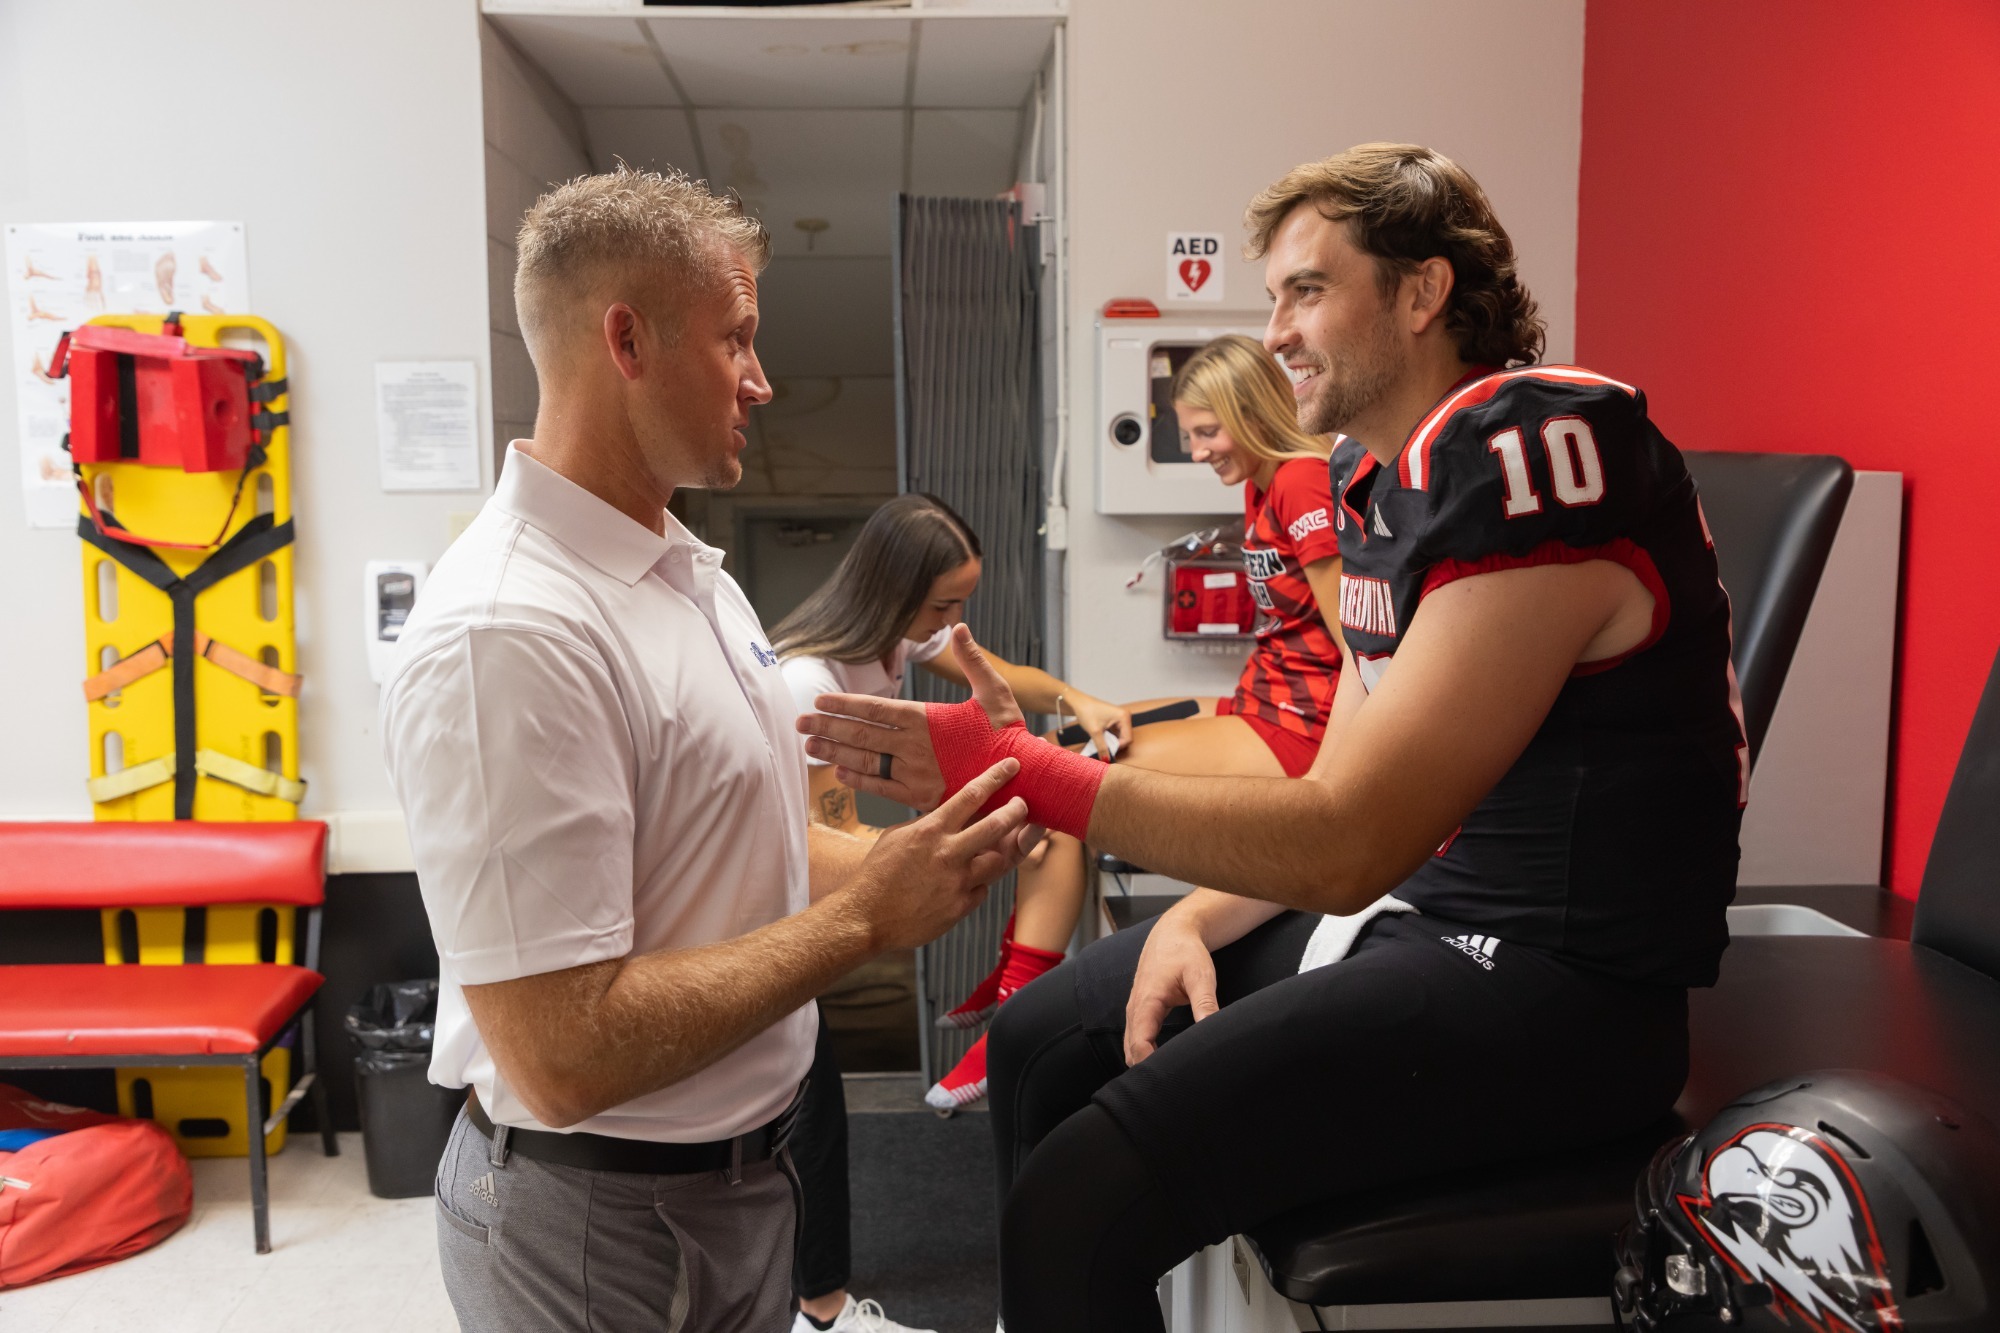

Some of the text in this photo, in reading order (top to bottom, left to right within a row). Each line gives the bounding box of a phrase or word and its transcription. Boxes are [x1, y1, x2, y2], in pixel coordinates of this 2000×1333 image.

[1172, 238, 1218, 255] AED
[1488, 414, 1607, 520] 10
[1288, 507, 1329, 542] WAC
[1241, 547, 1287, 580] ERN
[1440, 936, 1495, 971] adidas
[469, 1183, 498, 1207] adidas
